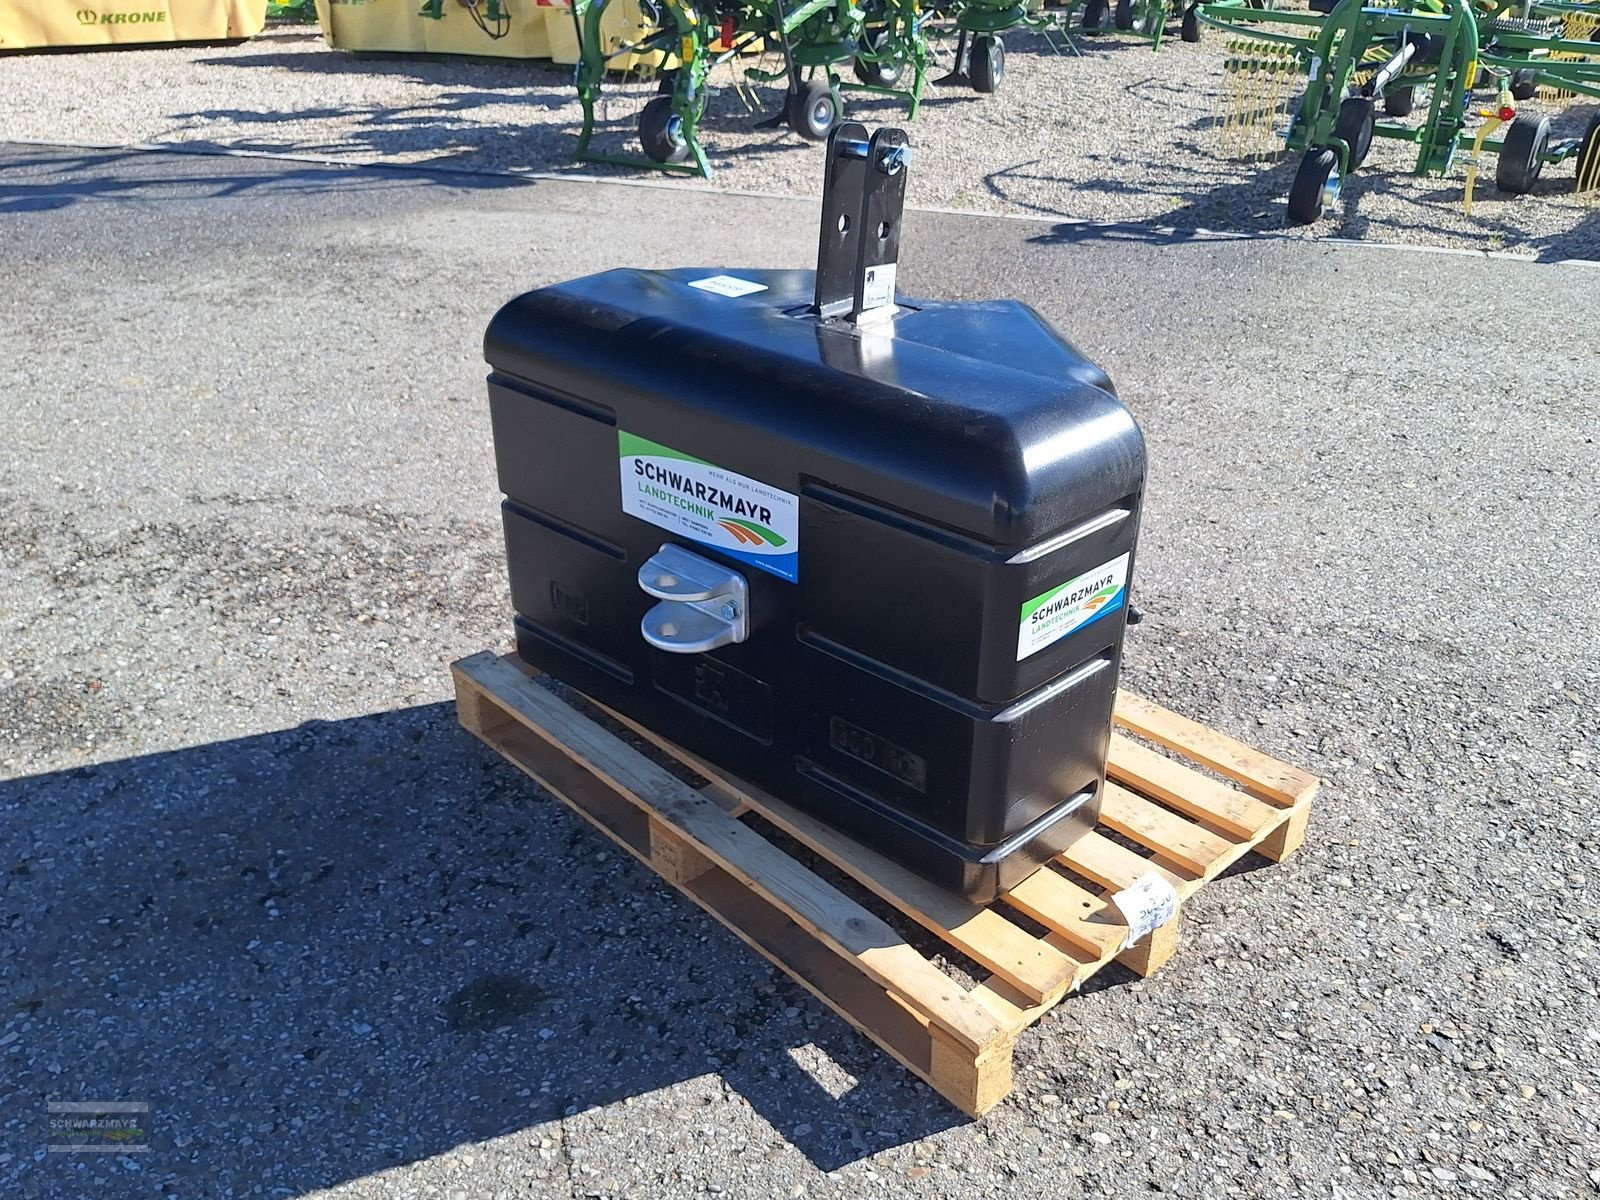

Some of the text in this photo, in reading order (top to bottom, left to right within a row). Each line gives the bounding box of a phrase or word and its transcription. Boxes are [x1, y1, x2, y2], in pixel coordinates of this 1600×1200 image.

[100, 11, 167, 25] KRONE
[634, 458, 771, 526] SCHWARZMAYR
[708, 470, 724, 480] MEHR
[726, 477, 737, 485] ALS
[638, 481, 715, 521] LANDTECHNIK
[1031, 574, 1113, 625] SCHWARZMAYR
[1031, 605, 1080, 635] LANDTECHNIK
